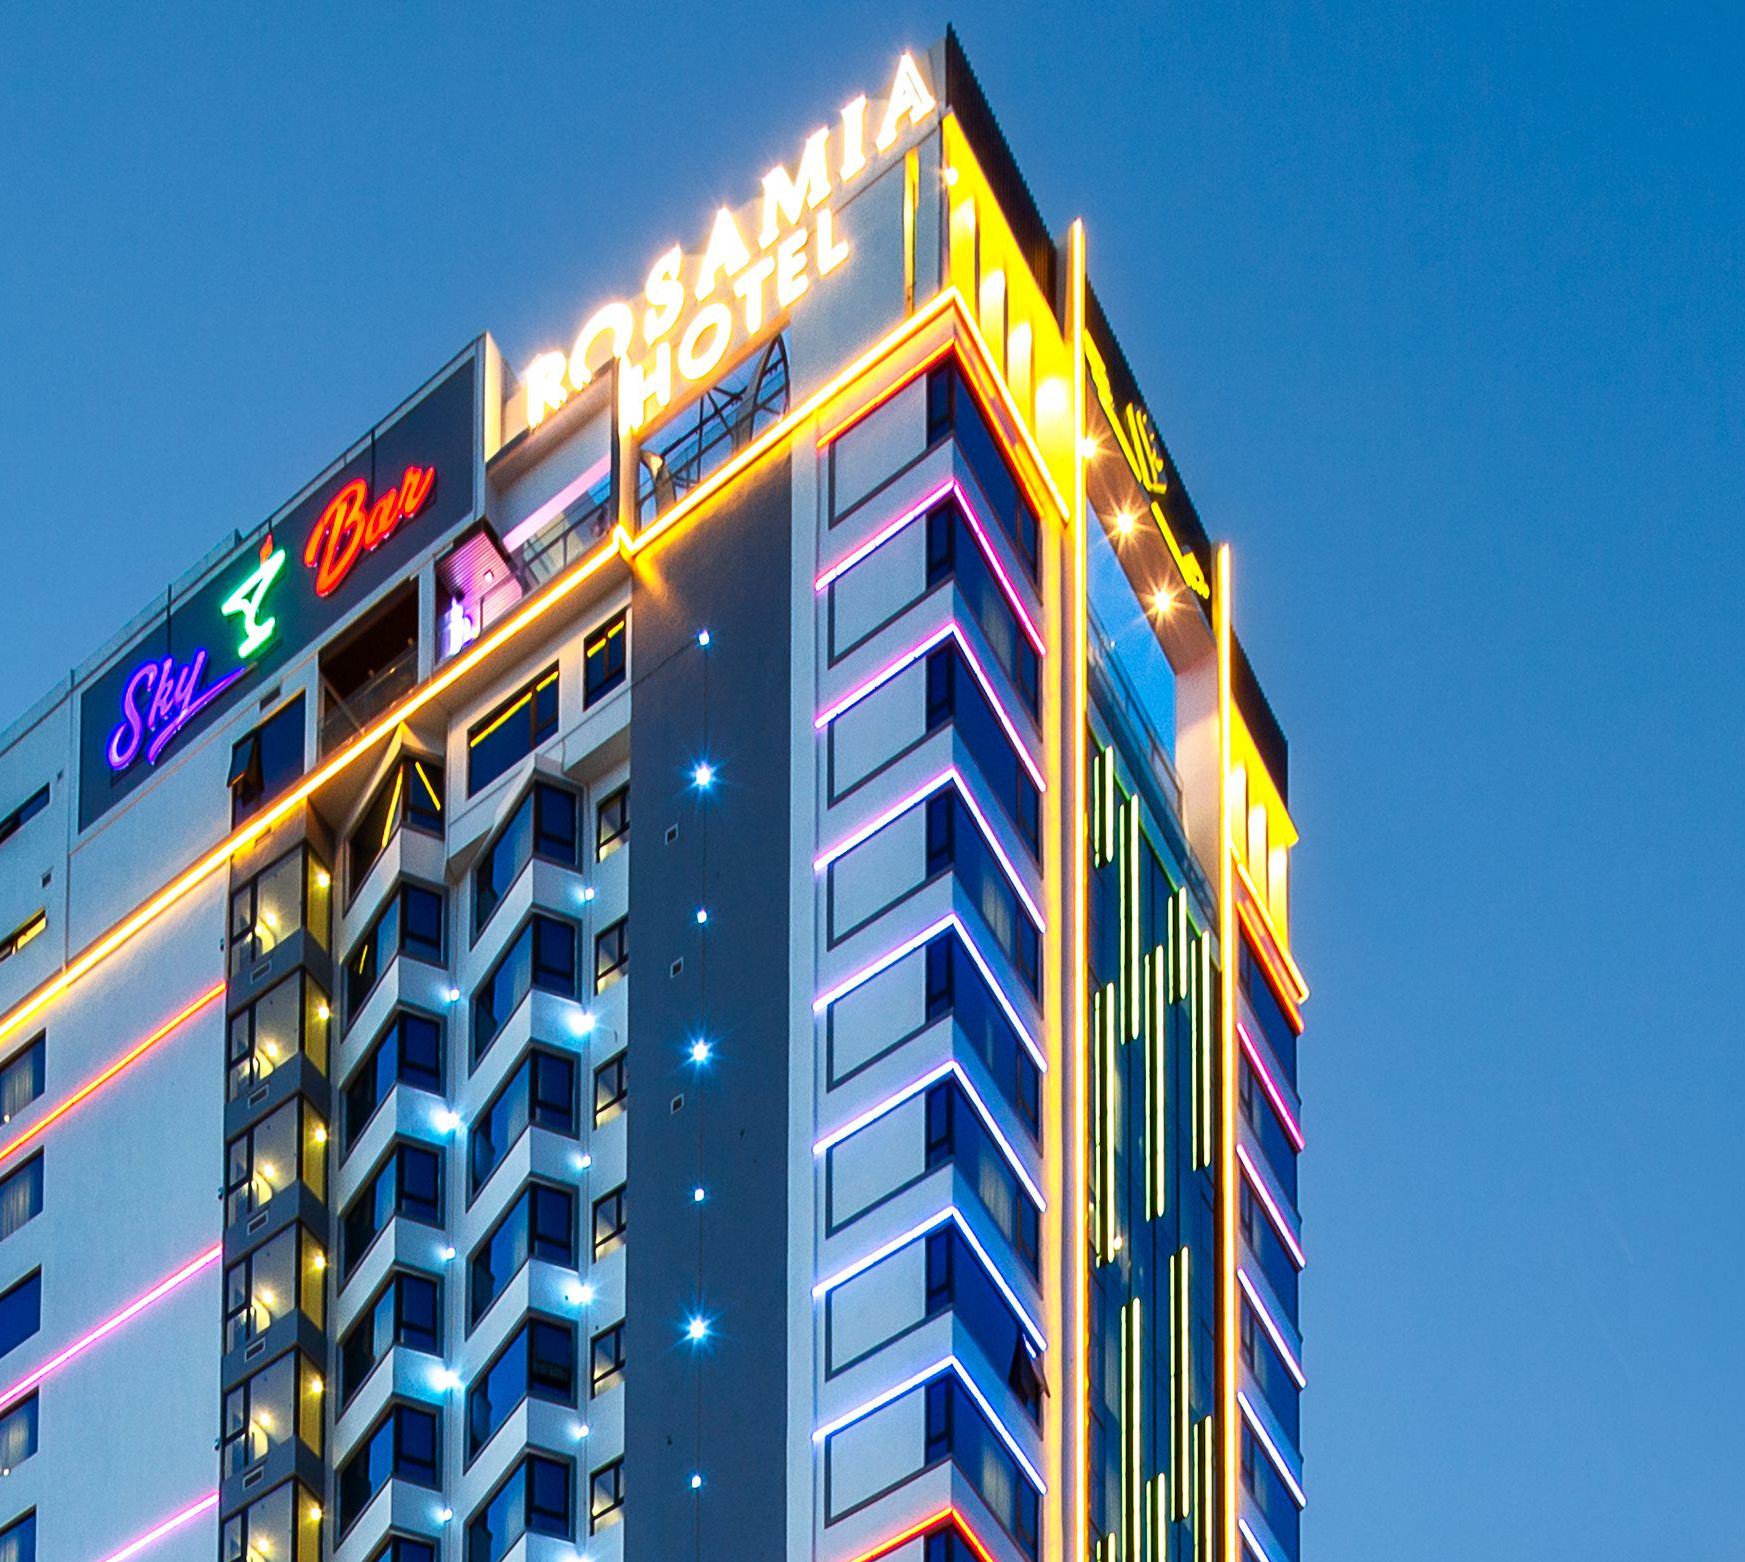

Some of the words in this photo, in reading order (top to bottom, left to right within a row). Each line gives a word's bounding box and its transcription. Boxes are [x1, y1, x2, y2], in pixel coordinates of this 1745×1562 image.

[523, 50, 937, 431] ROSAMIA
[617, 206, 849, 437] HOTEL
[107, 649, 247, 770] Sky
[305, 465, 435, 596] Bar
